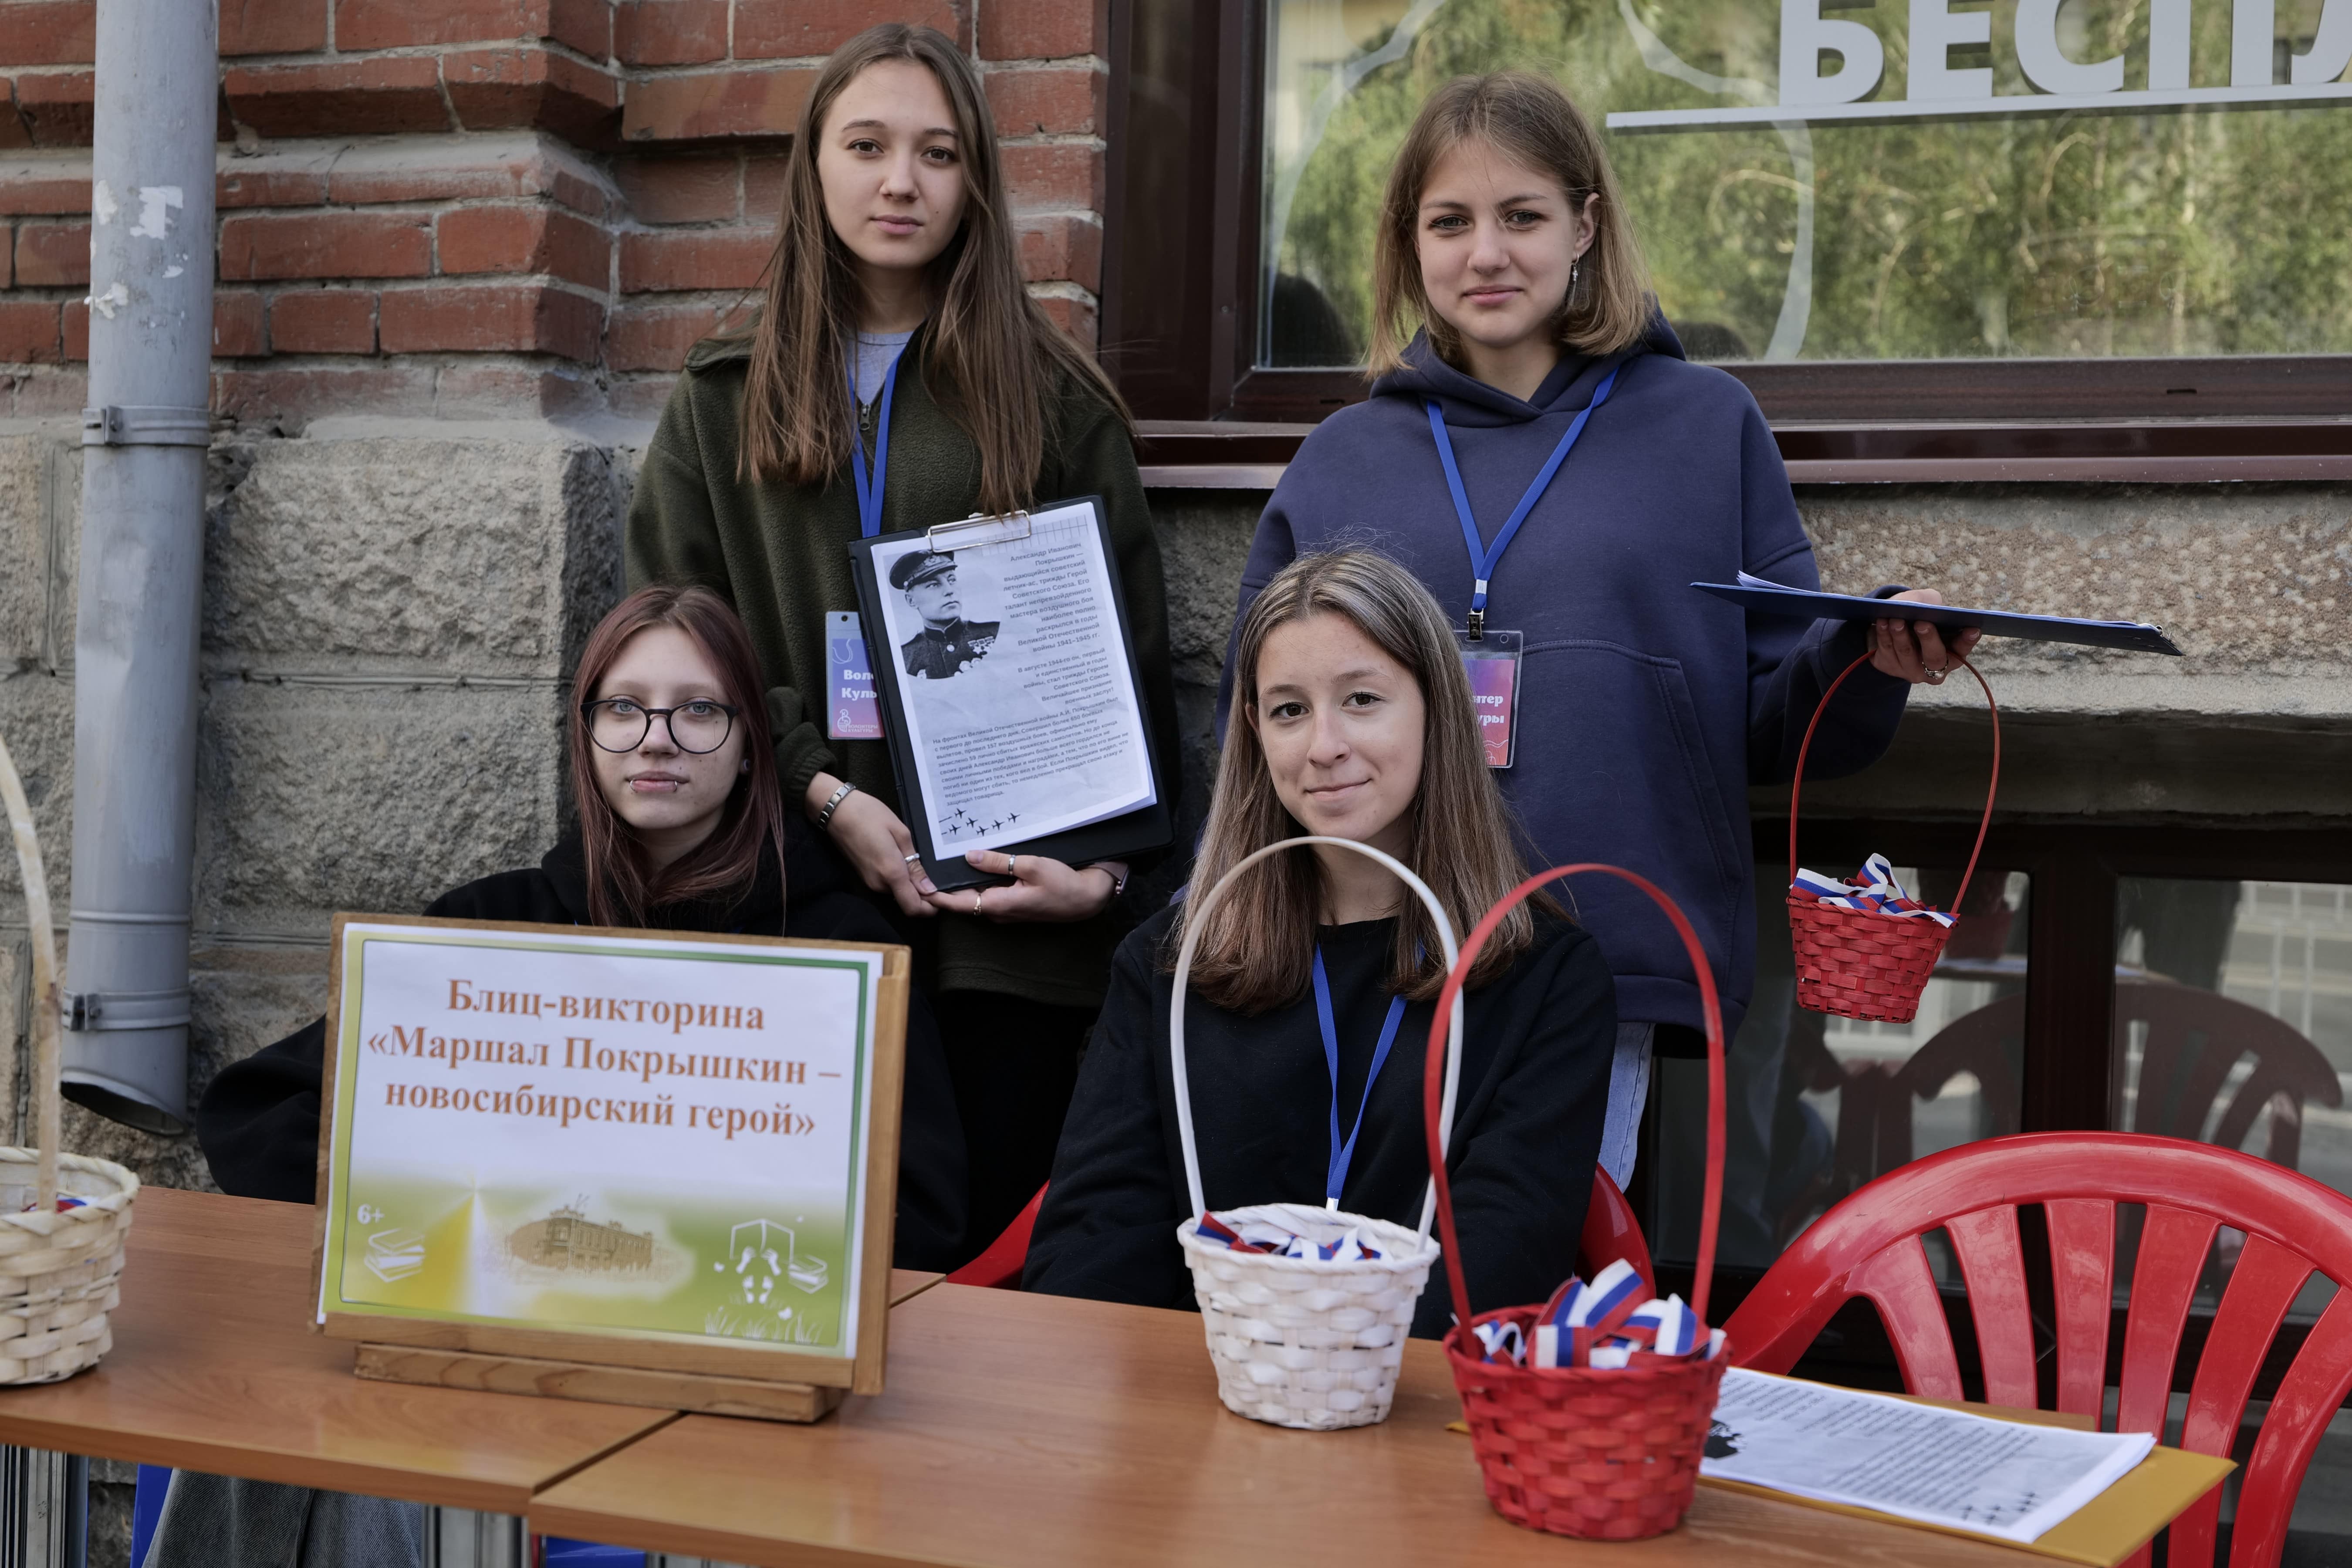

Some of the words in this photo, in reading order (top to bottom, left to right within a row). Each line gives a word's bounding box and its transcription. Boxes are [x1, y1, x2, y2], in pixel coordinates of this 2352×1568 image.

[1010, 551, 1046, 561] Александр
[1048, 543, 1081, 554] Иванович
[1035, 554, 1075, 566] Покрышкин
[1004, 569, 1049, 581] выдающийся
[1051, 560, 1085, 572] советский
[1004, 581, 1038, 591] летчик-ас,
[1040, 575, 1065, 584] трижды
[1067, 569, 1087, 578] Герой
[1012, 587, 1051, 599] Советского
[1052, 582, 1076, 591] Союза.
[1029, 588, 1091, 605] непревзойденного
[1010, 610, 1038, 618] мастера
[1039, 600, 1080, 612] воздушного
[1041, 612, 1073, 622] наиболее
[1075, 606, 1095, 614] полно
[1018, 635, 1047, 645] Великой
[1048, 622, 1099, 639] Отечественной
[1036, 621, 1073, 633] раскрылся
[1033, 644, 1055, 652] войны
[1049, 658, 1070, 666] 1944-го
[1082, 648, 1105, 658] первый
[1041, 661, 1085, 676] единственный
[1062, 671, 1085, 680] трижды
[1087, 664, 1108, 673] Героем
[1042, 689, 1079, 701] Величайшее
[1081, 680, 1112, 692] признание
[1054, 679, 1088, 690] Советского
[1065, 694, 1091, 704] военных
[1093, 687, 1113, 697] заслуг!
[942, 734, 966, 743] фронтах
[968, 728, 993, 737] Великой
[994, 718, 1038, 731] Отечественной
[1072, 701, 1105, 713] Покрышкин
[973, 733, 1007, 743] последнего
[1021, 723, 1051, 733] Совершил
[1081, 710, 1102, 718] боевых
[998, 736, 1031, 747] воздушных
[1050, 722, 1085, 734] официально
[938, 758, 968, 767] зачислено
[1020, 740, 1049, 750] вражеских
[974, 758, 1005, 767] Александр
[1006, 751, 1034, 761] Иванович
[1036, 746, 1058, 754] больше
[1076, 733, 1102, 743] гордился
[1065, 750, 1098, 762] Покрышкин
[965, 769, 991, 777] личными
[993, 762, 1021, 772] победами
[945, 789, 973, 798] ведомого
[1020, 770, 1054, 781] немедленно
[1055, 761, 1086, 772] прекращал
[947, 798, 973, 806] защищал
[448, 979, 764, 1034] Блиц-викторина
[368, 1024, 549, 1069] «Маршал
[563, 1037, 806, 1084] Покрышкин
[385, 1082, 674, 1128] новосибирский
[688, 1102, 815, 1140] герой»
[357, 1203, 385, 1224] 6+
